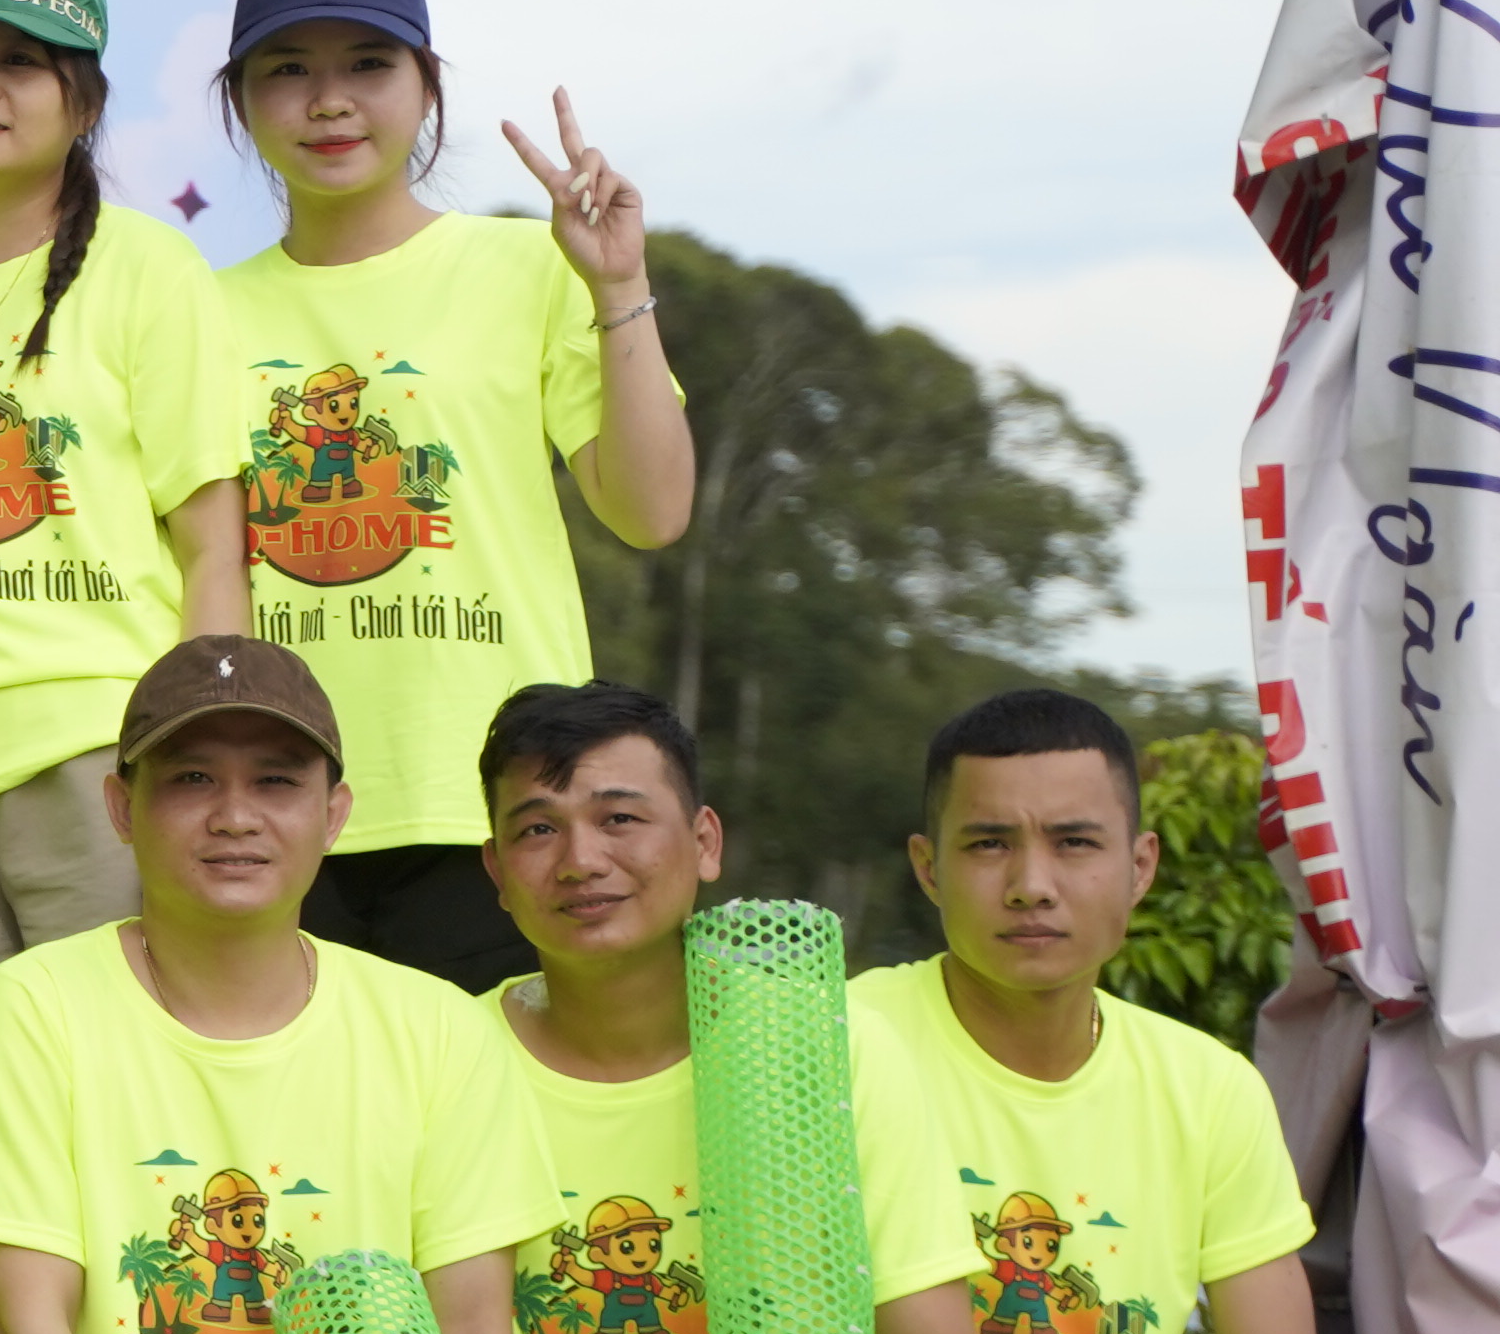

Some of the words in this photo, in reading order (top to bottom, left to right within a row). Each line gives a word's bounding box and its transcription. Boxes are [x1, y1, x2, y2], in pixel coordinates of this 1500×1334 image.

[44, 559, 78, 602] tới
[258, 597, 294, 645] tới
[300, 597, 325, 644] nơi
[350, 594, 403, 640] Chơi
[411, 594, 446, 639] tới
[455, 592, 503, 645] bến
